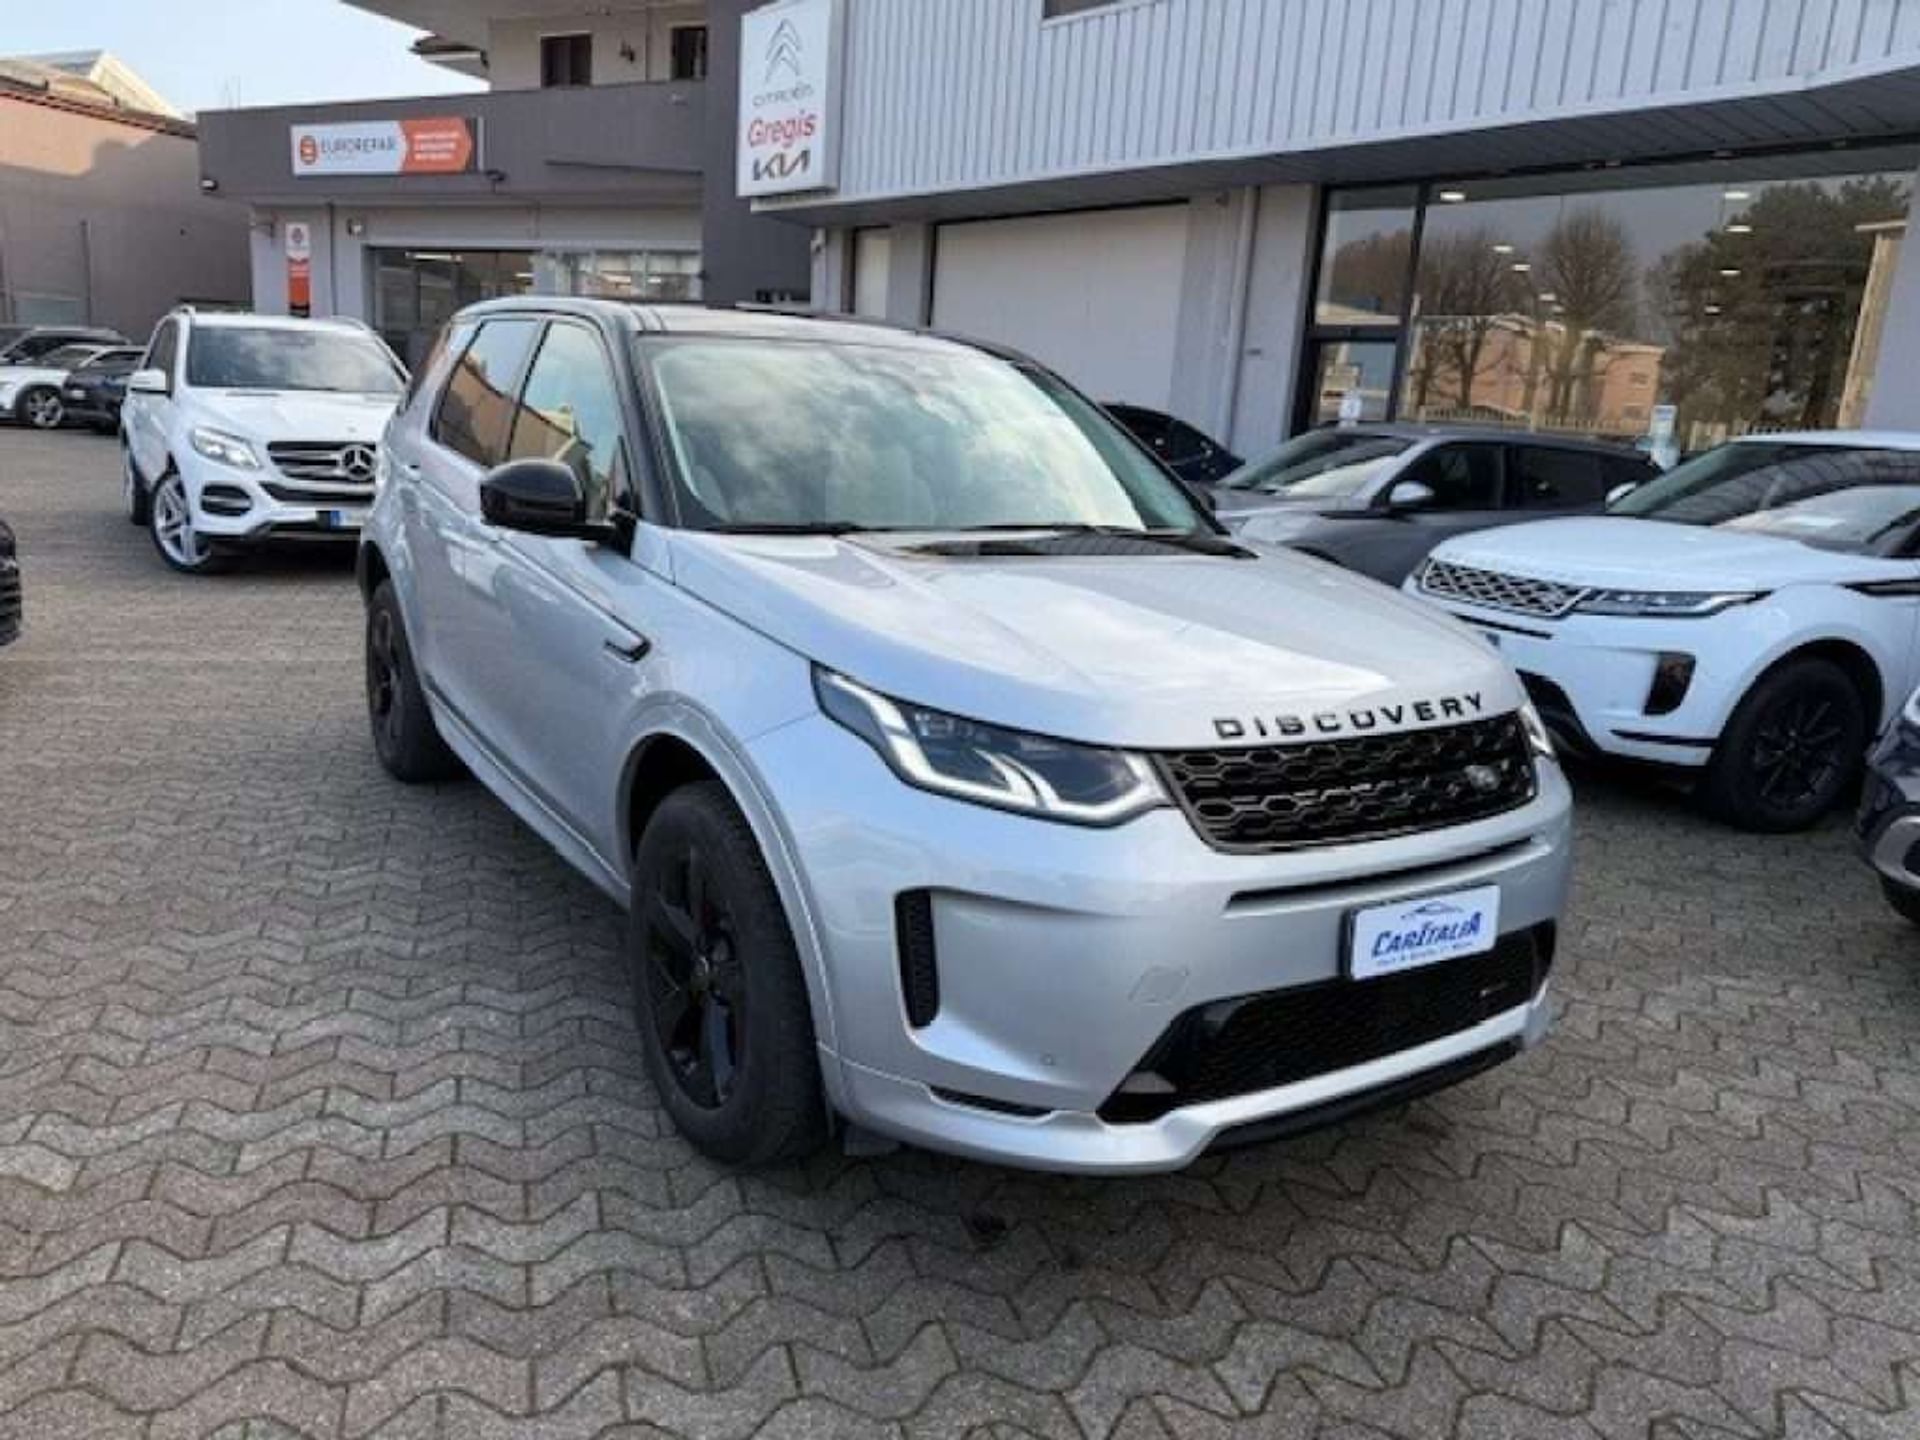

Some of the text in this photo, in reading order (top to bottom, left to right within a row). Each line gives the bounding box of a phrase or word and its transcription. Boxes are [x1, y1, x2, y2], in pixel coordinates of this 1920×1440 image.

[749, 109, 816, 148] Gregis
[752, 149, 811, 181] KIA
[1213, 692, 1484, 739] DISCOVERY
